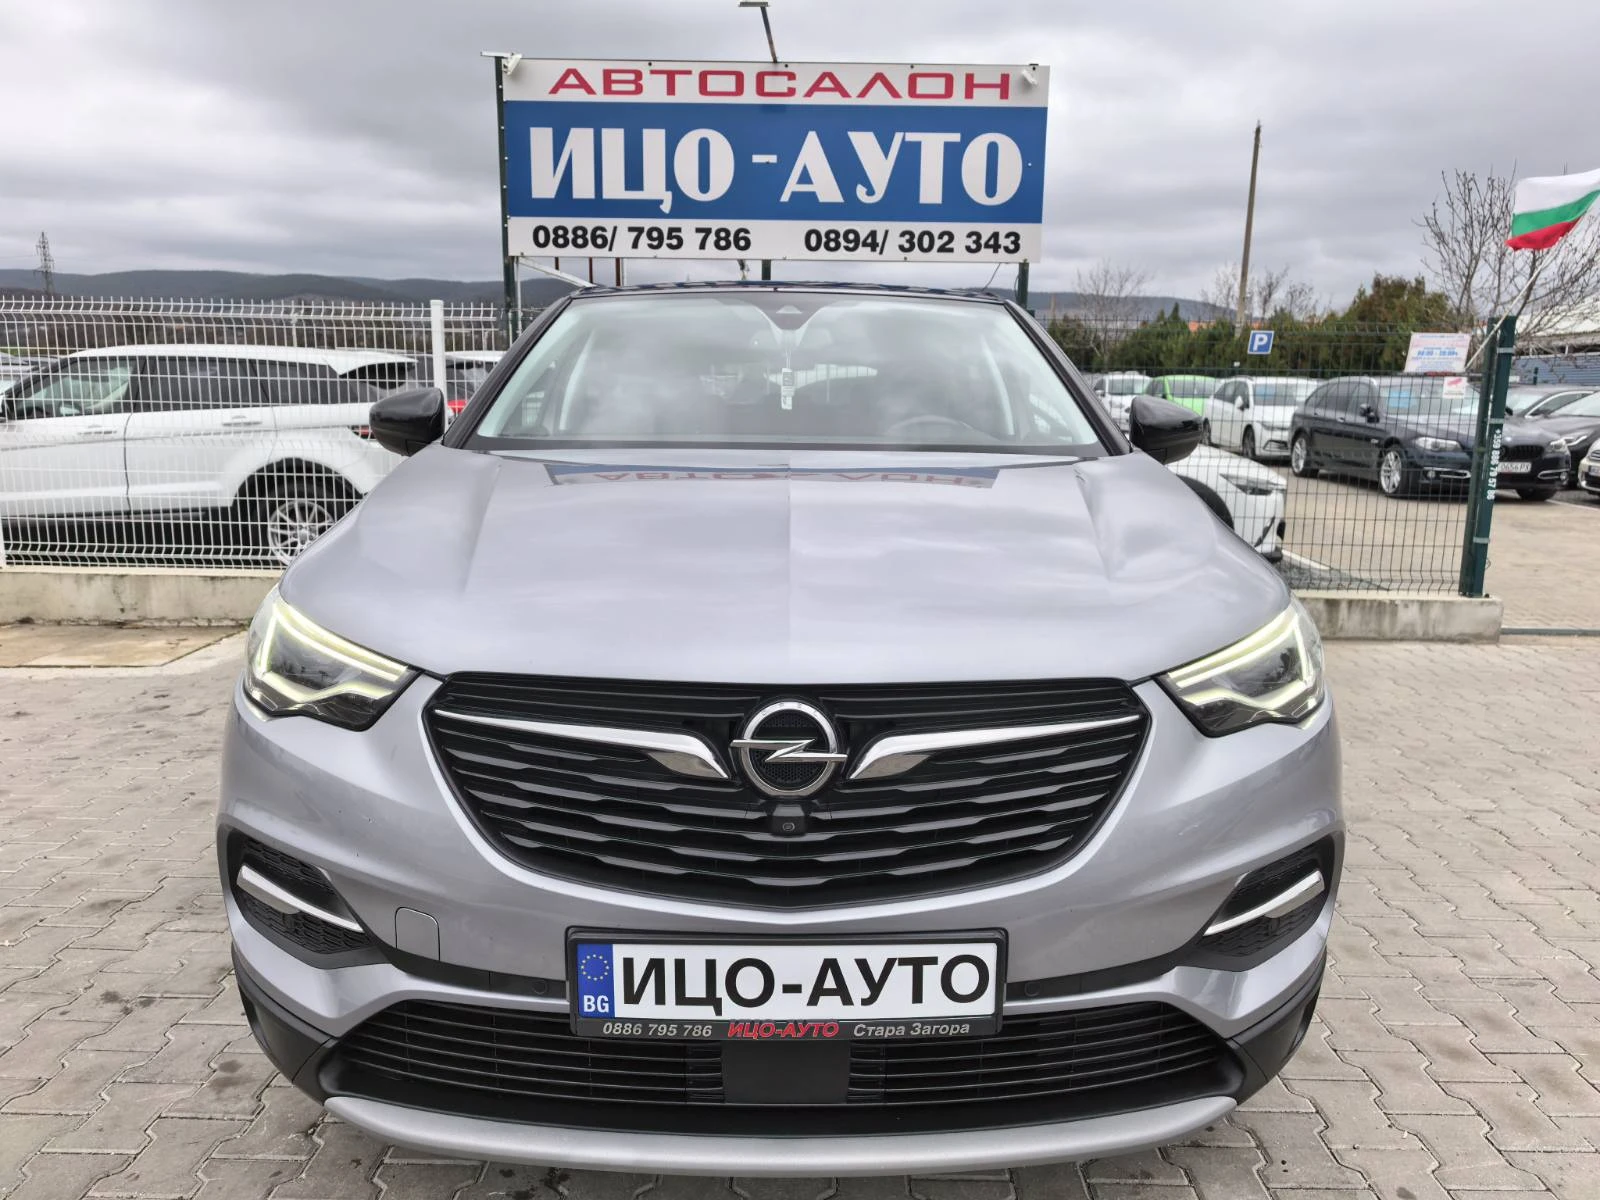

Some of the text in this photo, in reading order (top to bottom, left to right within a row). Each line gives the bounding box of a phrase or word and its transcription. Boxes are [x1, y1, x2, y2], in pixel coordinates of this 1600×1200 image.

[548, 67, 1011, 100] АВТОСАЛОН
[532, 225, 752, 252] 0886/ 795 786
[804, 228, 1021, 255] 0894/ 302 343
[1253, 334, 1268, 351] P
[622, 954, 990, 1016] ИЦО-АУТО
[583, 994, 609, 1013] BG
[603, 1022, 713, 1037] 0886 795 786
[727, 1021, 840, 1039] ИЦО-АУТО
[853, 1022, 970, 1038] Стара Загора
